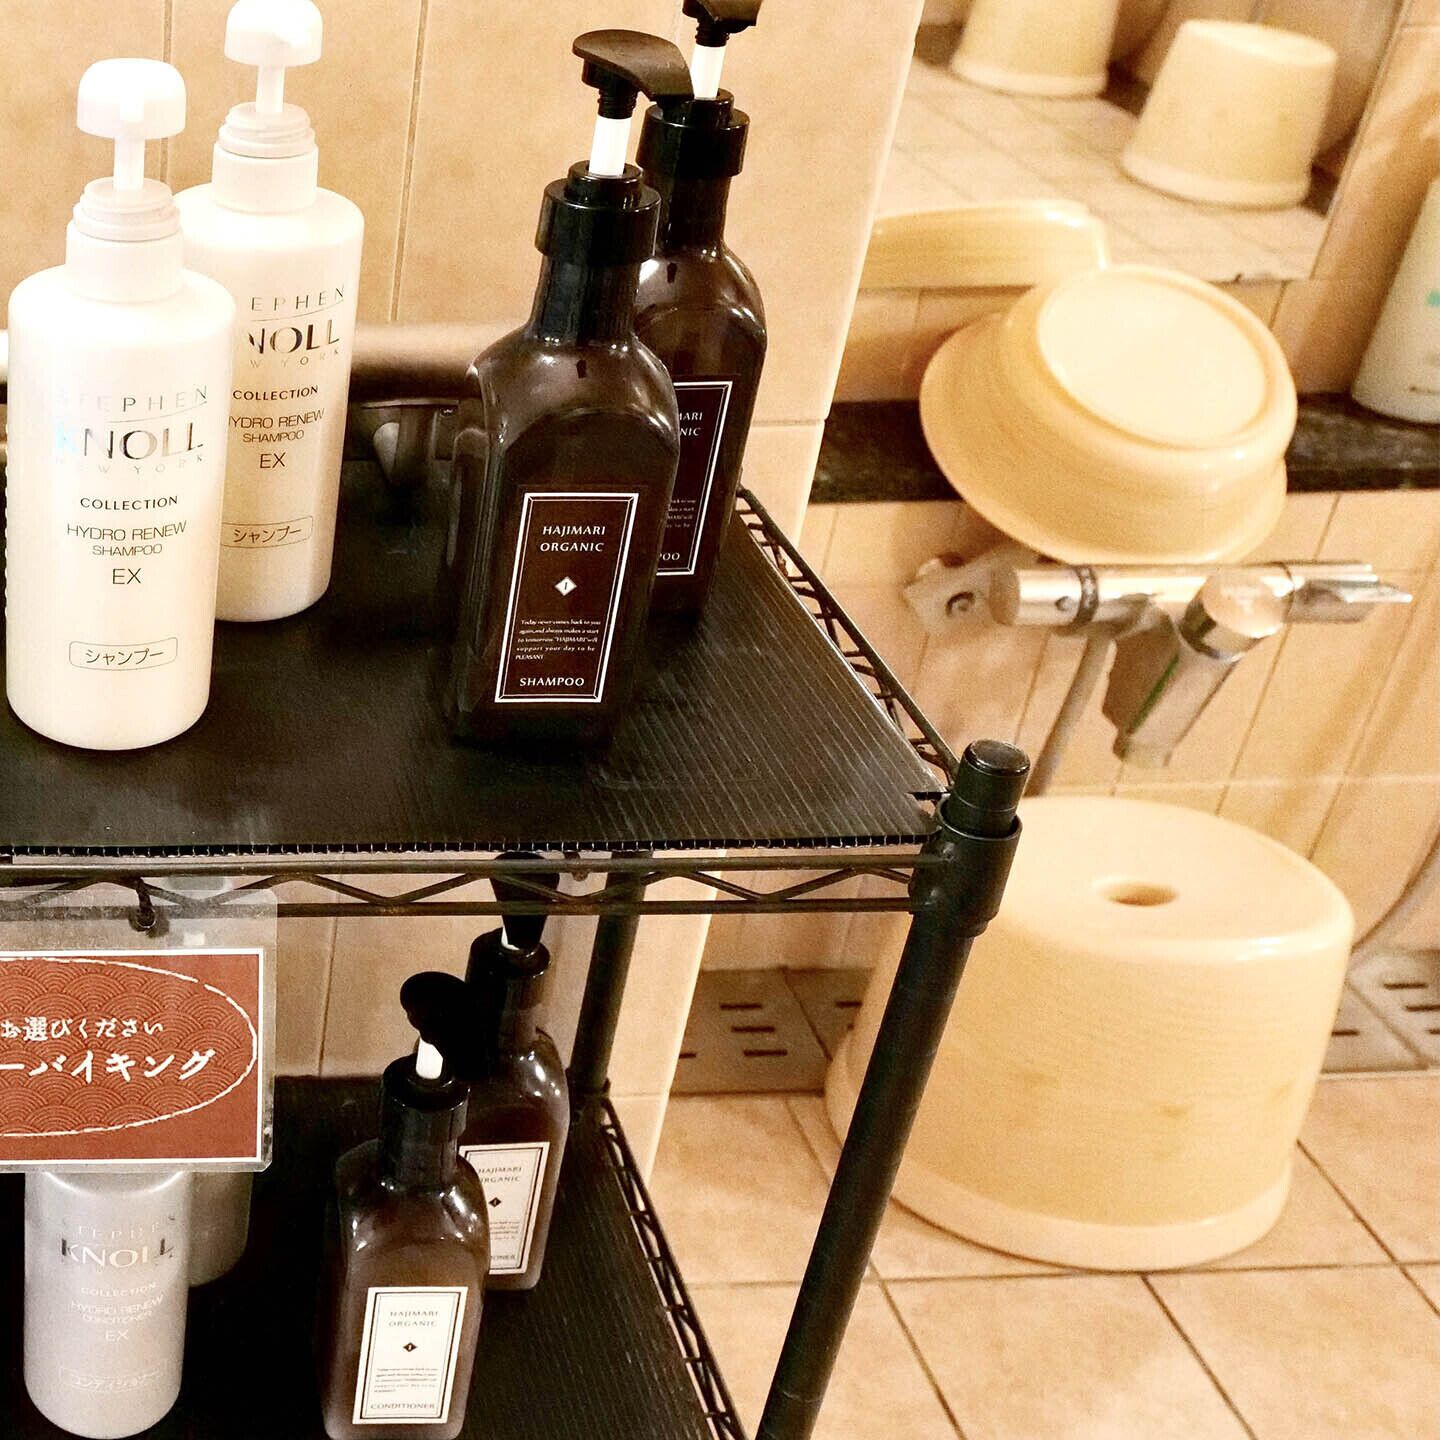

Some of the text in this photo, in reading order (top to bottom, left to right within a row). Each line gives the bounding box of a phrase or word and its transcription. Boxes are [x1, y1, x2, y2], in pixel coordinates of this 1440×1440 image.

[251, 284, 344, 311] EPHEN
[247, 320, 340, 354] NOLL
[232, 384, 318, 401] COLLECTION
[278, 408, 325, 428] RENEW
[242, 430, 305, 443] SHAMPOO
[260, 452, 286, 469] EX
[80, 496, 178, 511] COLLECTION
[67, 520, 187, 542] HYDRO RENEW
[233, 525, 302, 544] シャンプー
[542, 525, 606, 538] HAJIMARI
[92, 543, 163, 557] SHAMPOO
[539, 542, 605, 553] ORGANIC
[112, 568, 142, 585] EX
[85, 647, 165, 666] シャンプー
[519, 677, 585, 687] SHAMPOO
[105, 1329, 129, 1343] EX
